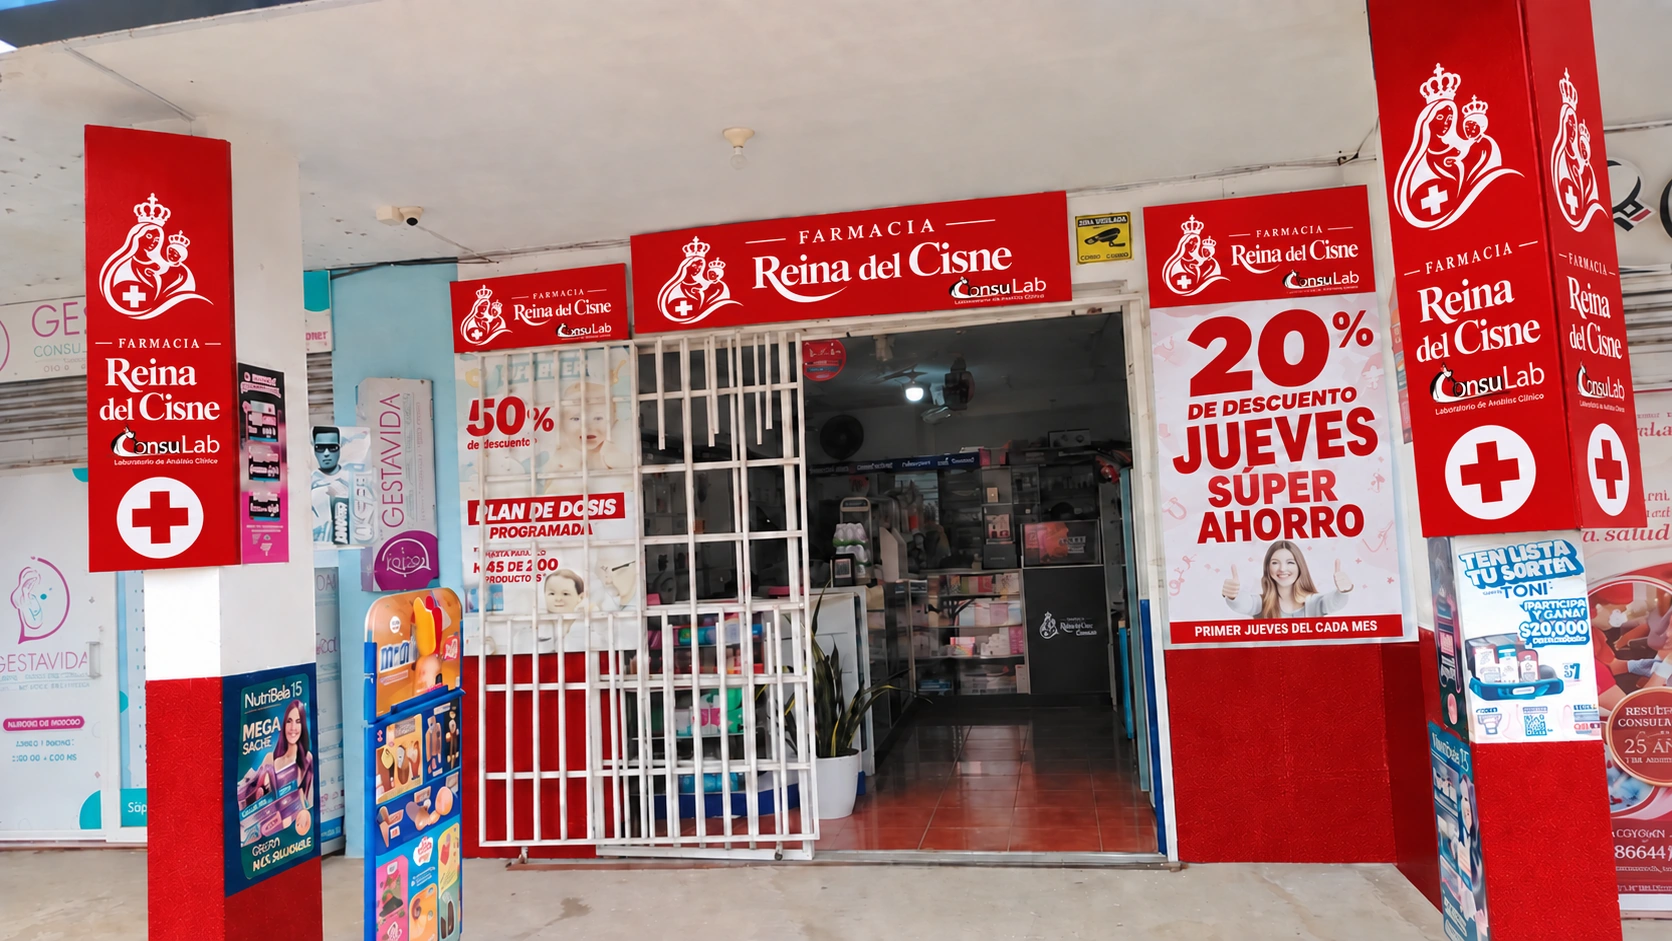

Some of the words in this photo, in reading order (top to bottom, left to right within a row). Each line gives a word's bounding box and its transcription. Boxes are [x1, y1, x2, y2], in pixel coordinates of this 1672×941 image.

[799, 218, 934, 245] FARMACIA
[1256, 225, 1323, 238] FARMACIA
[1230, 243, 1282, 275] Reina
[1285, 246, 1307, 261] del
[1309, 239, 1359, 261] Cisne
[1425, 241, 1513, 275] FARMACIA
[1568, 252, 1608, 276] FARMACIA
[752, 253, 852, 304] Reina
[858, 252, 902, 281] del
[908, 241, 1013, 277] Cisne
[533, 288, 585, 300] FARMACIA
[1417, 278, 1515, 325] Reina
[1567, 275, 1612, 320] Reina
[32, 301, 86, 338] GE
[513, 303, 553, 327] Reina
[555, 304, 571, 317] del
[574, 298, 612, 316] Cisne
[118, 338, 200, 349] FARMACIA
[1187, 308, 1375, 398] 20%
[1416, 331, 1451, 363] del
[1454, 318, 1542, 355] Cisne
[1569, 323, 1586, 352] del
[1586, 321, 1623, 360] Cisne
[105, 358, 198, 393] Reina
[99, 399, 133, 421] del
[139, 392, 220, 421] Cisne
[1188, 401, 1218, 421] DE
[1222, 386, 1357, 417] DESCUENTO
[467, 440, 480, 450] de
[1172, 406, 1379, 475] JUEVES
[379, 393, 406, 529] GESTAVIDA
[1208, 466, 1339, 508] SÚPER
[475, 502, 526, 522] PLAN
[529, 501, 554, 519] DE
[559, 498, 617, 517] DOSIS
[1197, 503, 1365, 544] AHORRO
[489, 523, 593, 539] PROGRAMADA
[1460, 549, 1508, 570] TEN
[1508, 540, 1571, 563] LISTA
[1466, 566, 1498, 586] TU
[1500, 582, 1549, 599] TONI
[1194, 623, 1242, 637] PRIMER
[1243, 622, 1289, 636] JUEVES
[1291, 621, 1313, 634] DEL
[1315, 620, 1349, 633] CADA
[1351, 620, 1378, 632] MES
[1519, 620, 1589, 637] $20,000
[1532, 610, 1542, 620] Y
[291, 681, 303, 697] 15
[242, 716, 281, 742] MEGA
[1624, 738, 1647, 755] 25
